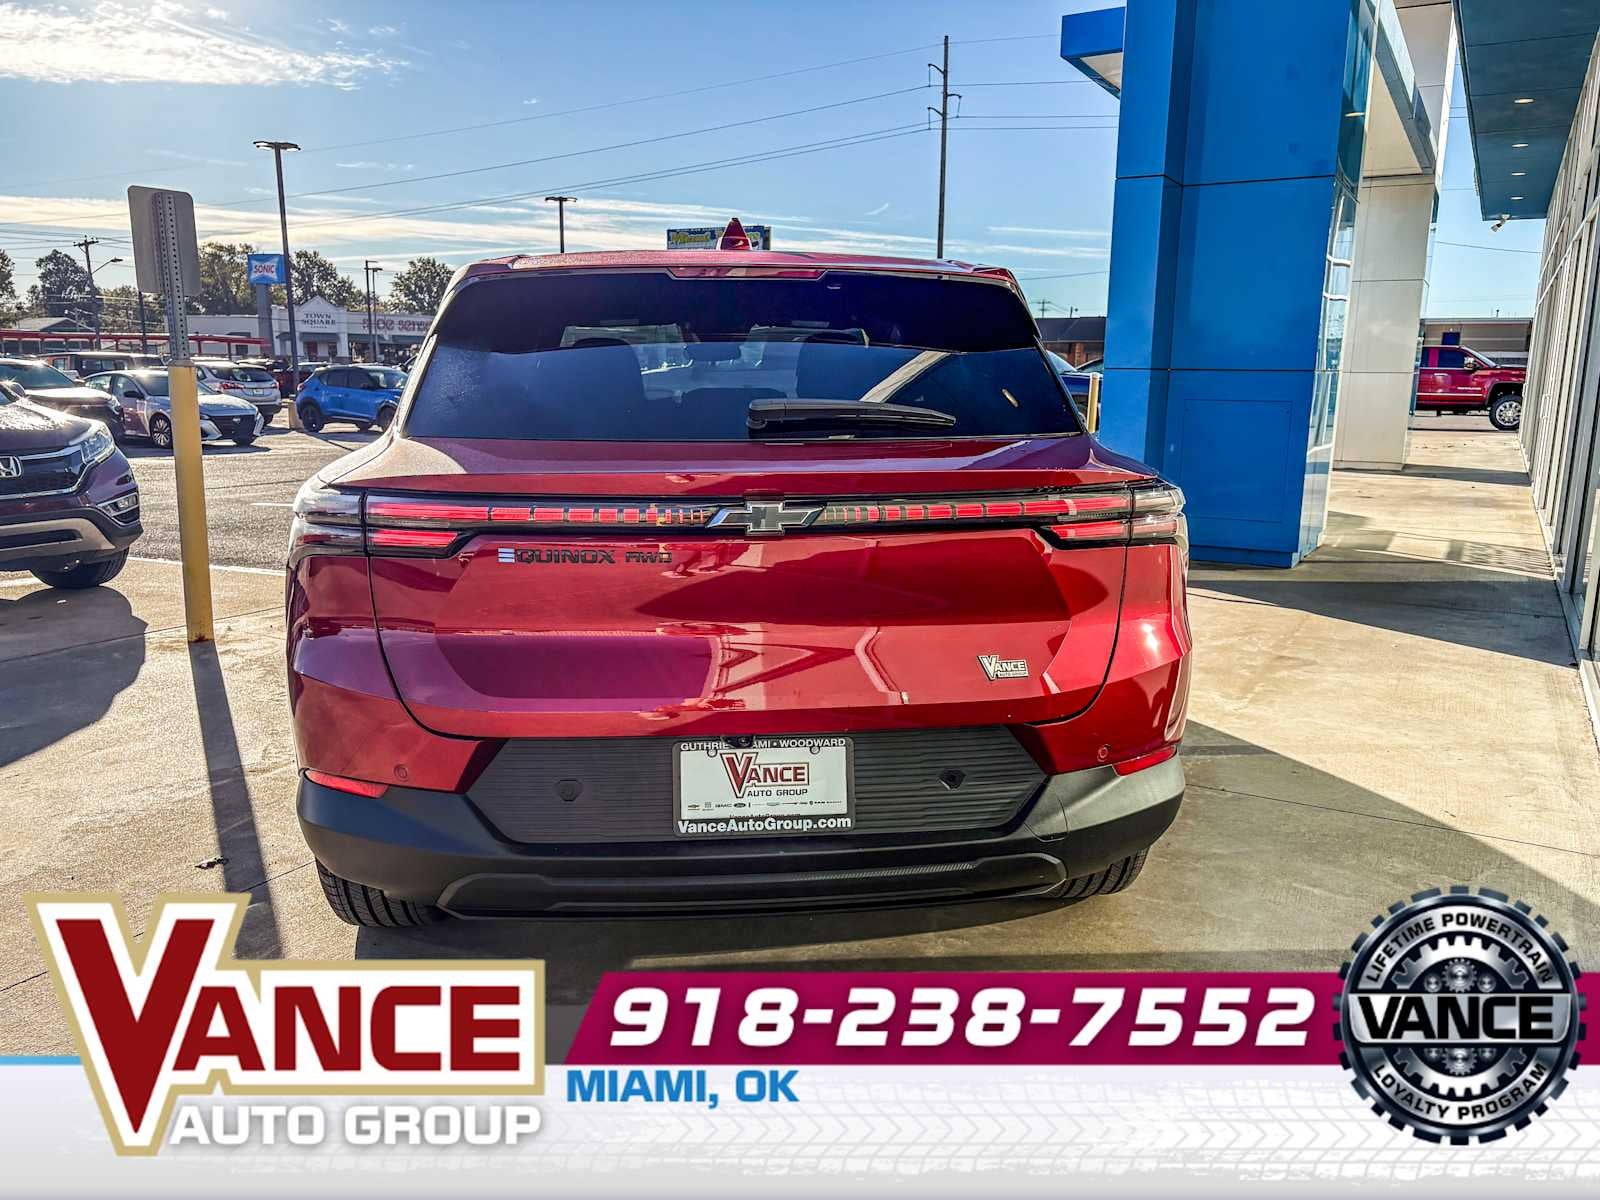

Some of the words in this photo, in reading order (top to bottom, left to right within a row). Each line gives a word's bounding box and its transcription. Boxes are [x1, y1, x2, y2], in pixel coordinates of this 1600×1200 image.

[254, 264, 274, 274] SONIC
[497, 547, 616, 564] EQUINOX
[625, 551, 672, 563] AWD
[980, 656, 1026, 678] VANCE
[779, 738, 846, 748] WOODWARD
[723, 754, 807, 796] VANCE
[747, 789, 772, 797] AUTO
[776, 788, 808, 796] GROUP
[677, 817, 851, 834] VanceAutoGroup.com
